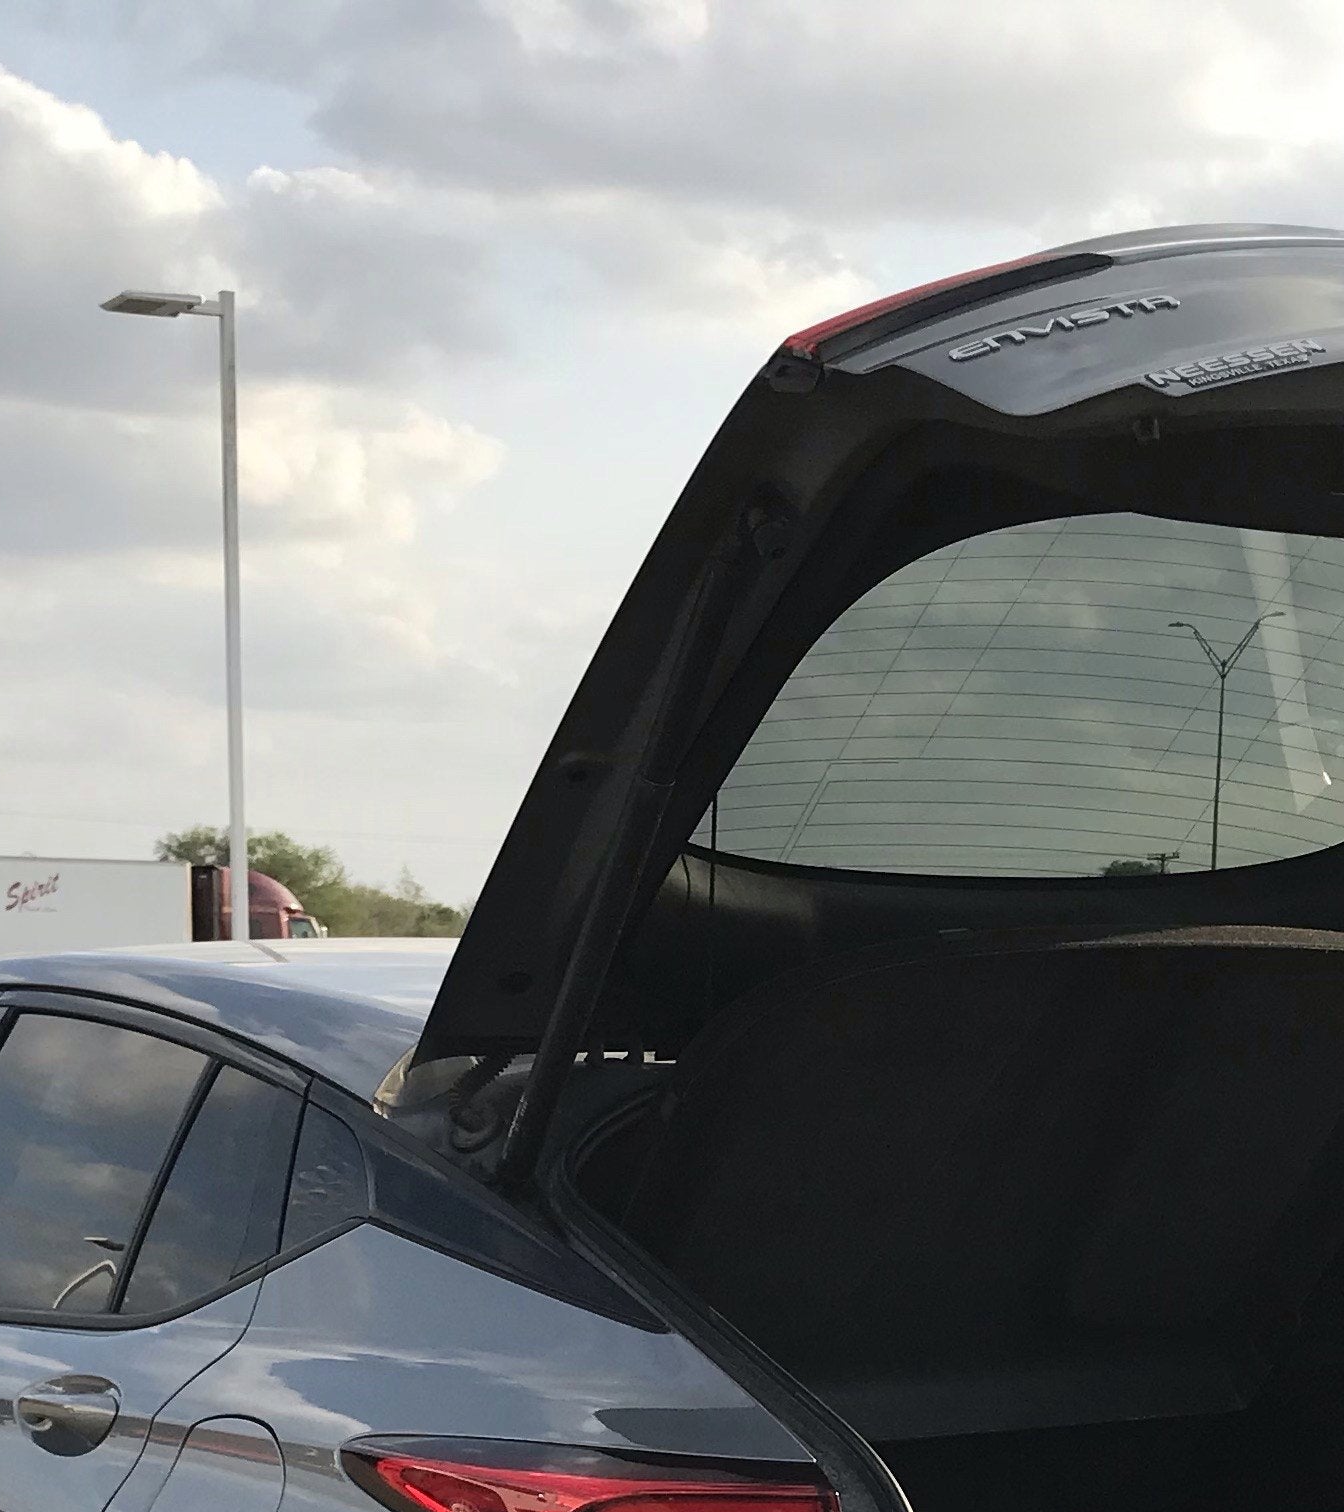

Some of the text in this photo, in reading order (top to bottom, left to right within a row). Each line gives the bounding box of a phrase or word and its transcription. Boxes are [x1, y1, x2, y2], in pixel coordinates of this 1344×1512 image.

[948, 294, 1181, 361] ENVISTA
[1145, 338, 1327, 388] NEESSEN
[5, 873, 59, 912] Spirit
